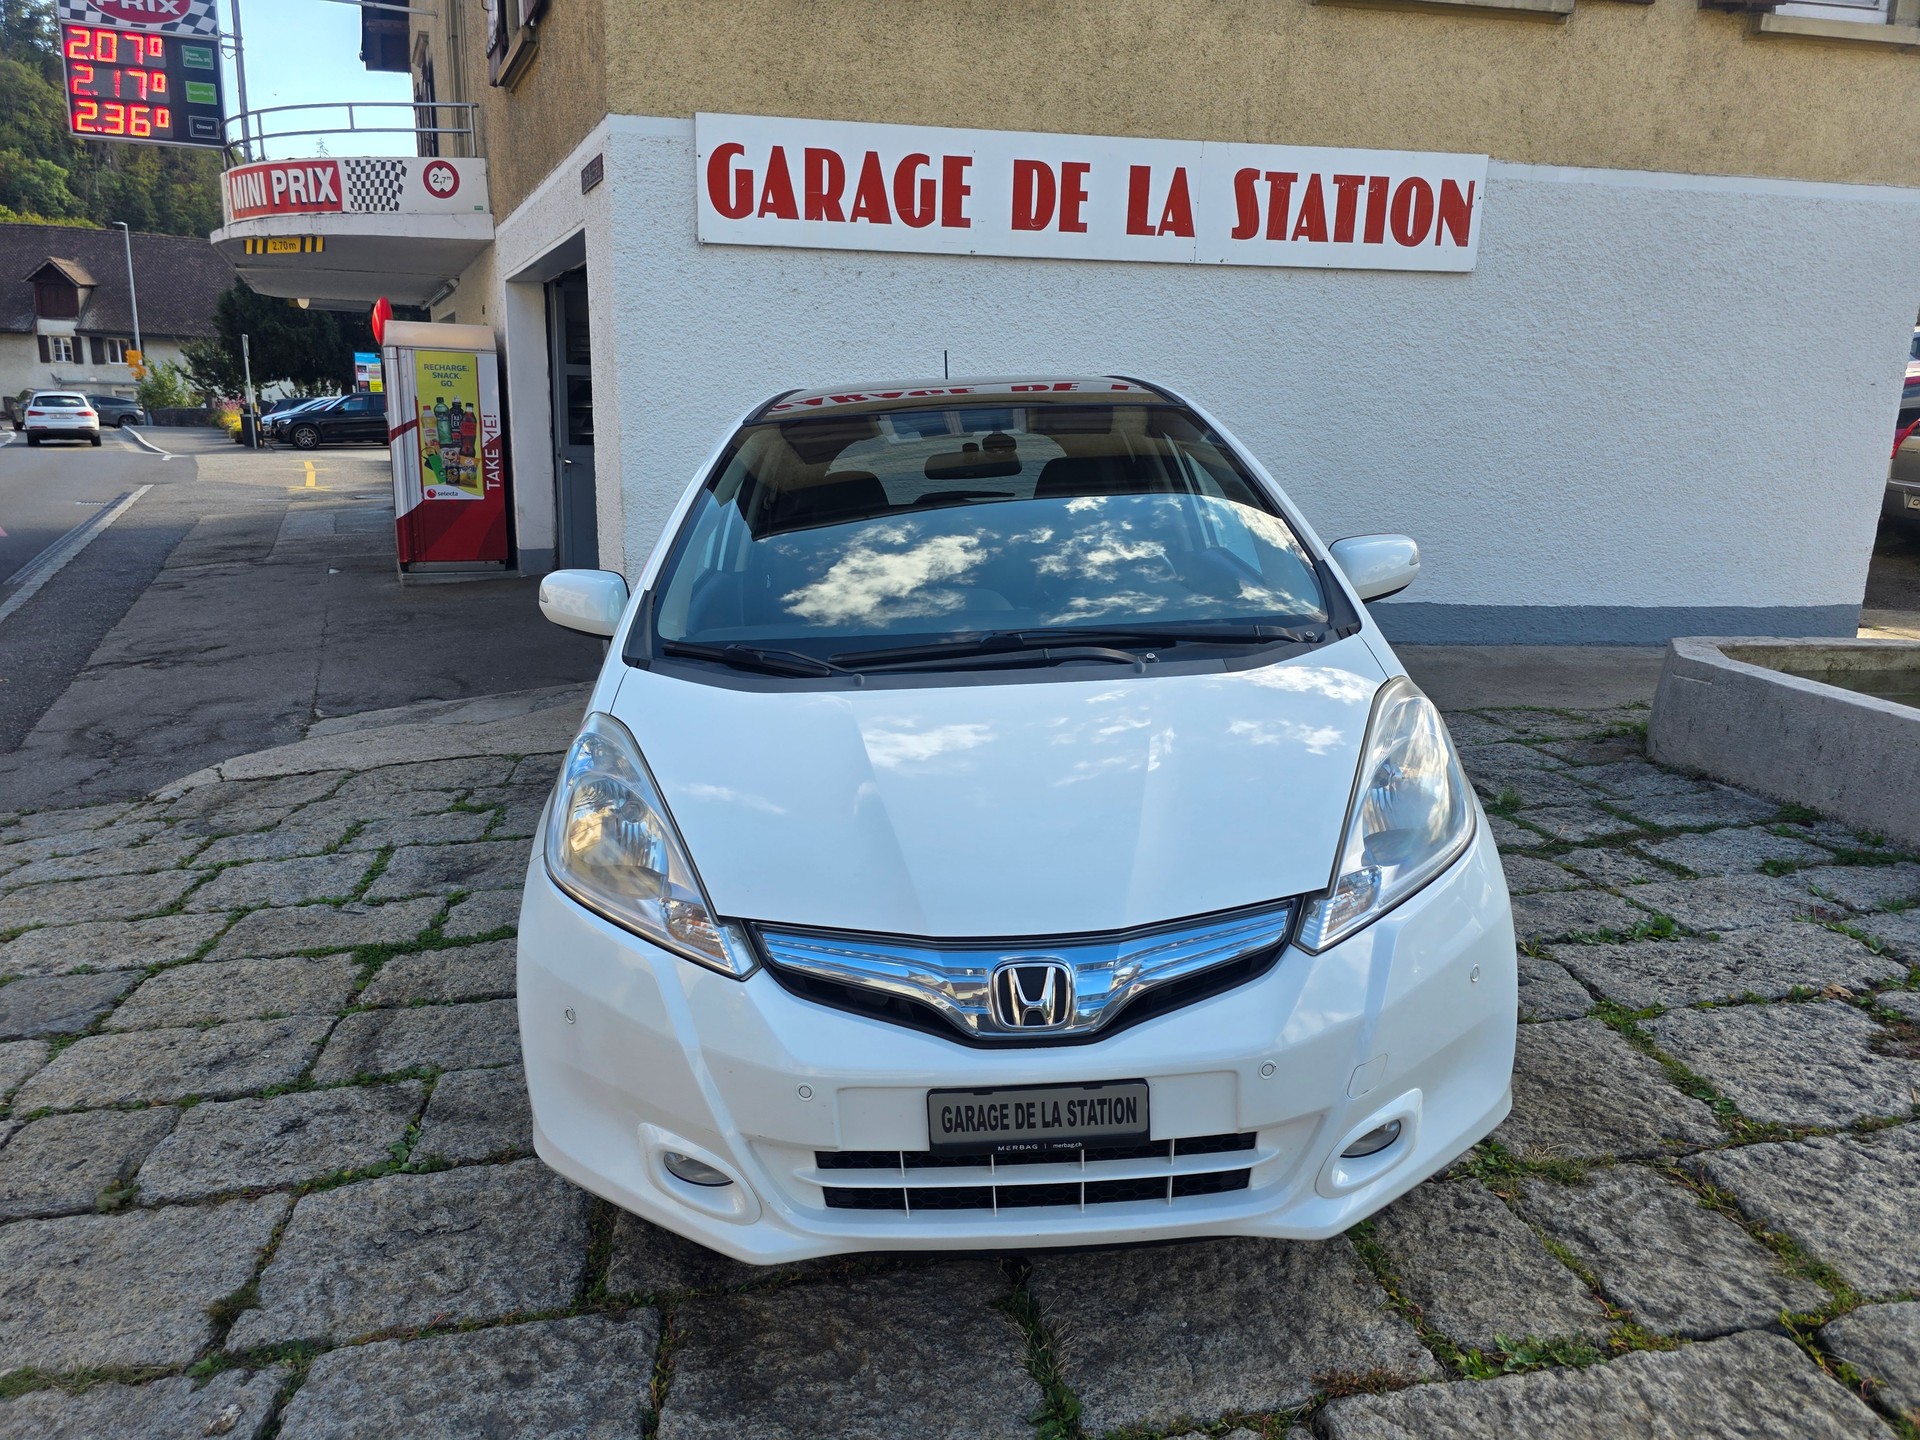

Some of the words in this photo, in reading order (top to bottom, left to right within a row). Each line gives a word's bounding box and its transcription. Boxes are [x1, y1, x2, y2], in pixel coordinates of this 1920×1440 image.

[96, 0, 181, 15] RIX
[231, 171, 268, 211] MINI
[270, 167, 338, 206] PRIX
[707, 142, 973, 228] GARAGE
[1011, 159, 1091, 233] DE
[1126, 165, 1195, 237] LA
[1231, 167, 1475, 247] STATION
[272, 241, 297, 251] 2.70m
[424, 363, 470, 372] RECHARGE.
[432, 371, 462, 380] SNACK.
[440, 380, 455, 388] GO.
[483, 414, 498, 444] ME!
[484, 449, 501, 491] TAKE
[941, 1104, 1010, 1133] GARAGE
[1014, 1102, 1037, 1129] DE
[1041, 1100, 1063, 1128] LA
[1067, 1096, 1137, 1127] STATION
